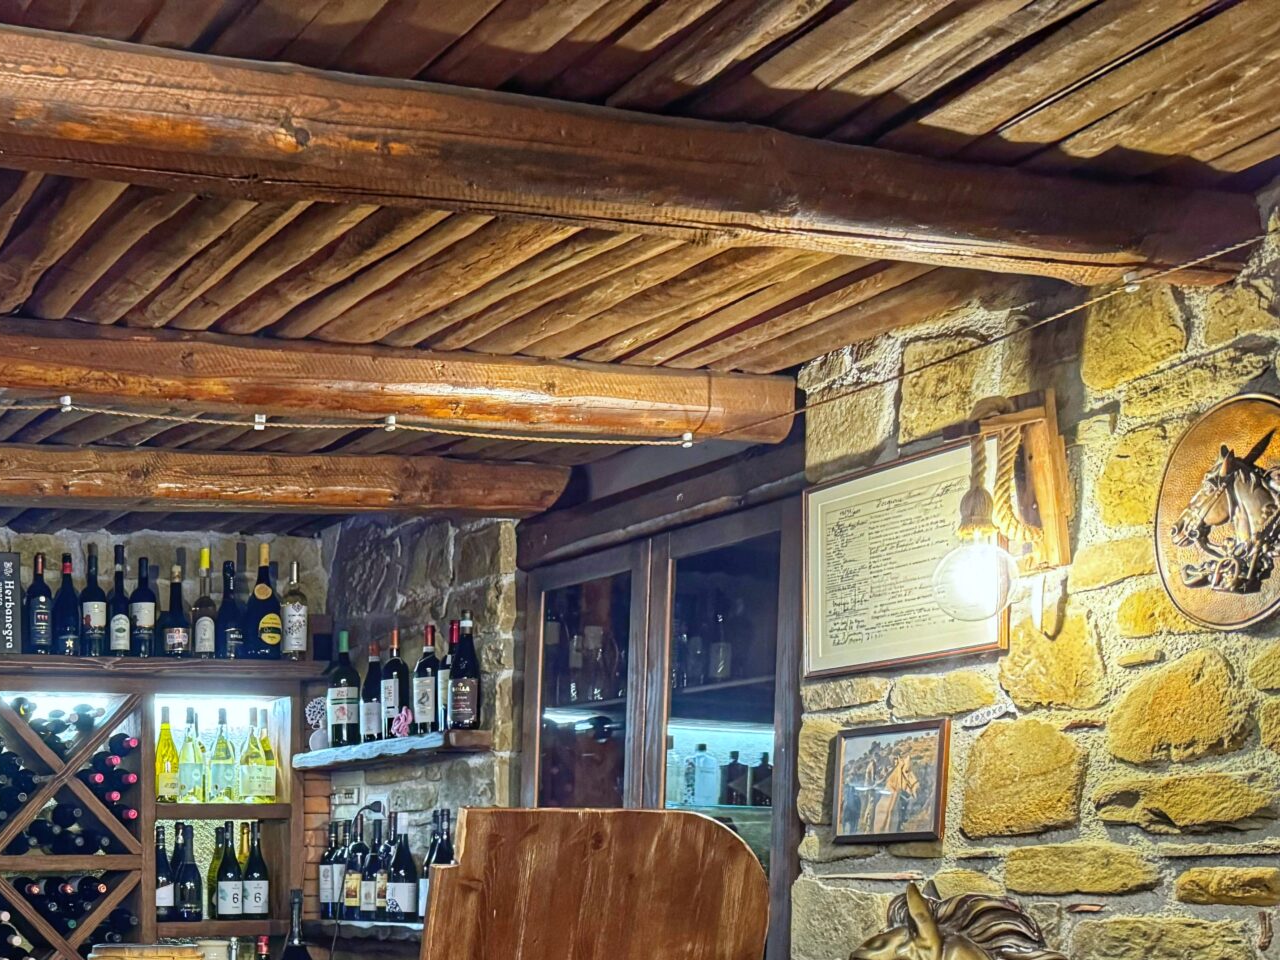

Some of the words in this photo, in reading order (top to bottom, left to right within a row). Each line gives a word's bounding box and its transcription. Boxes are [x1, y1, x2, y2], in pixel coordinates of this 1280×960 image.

[2, 580, 15, 649] Herbanegra
[232, 893, 239, 904] 6
[254, 892, 261, 903] 6
